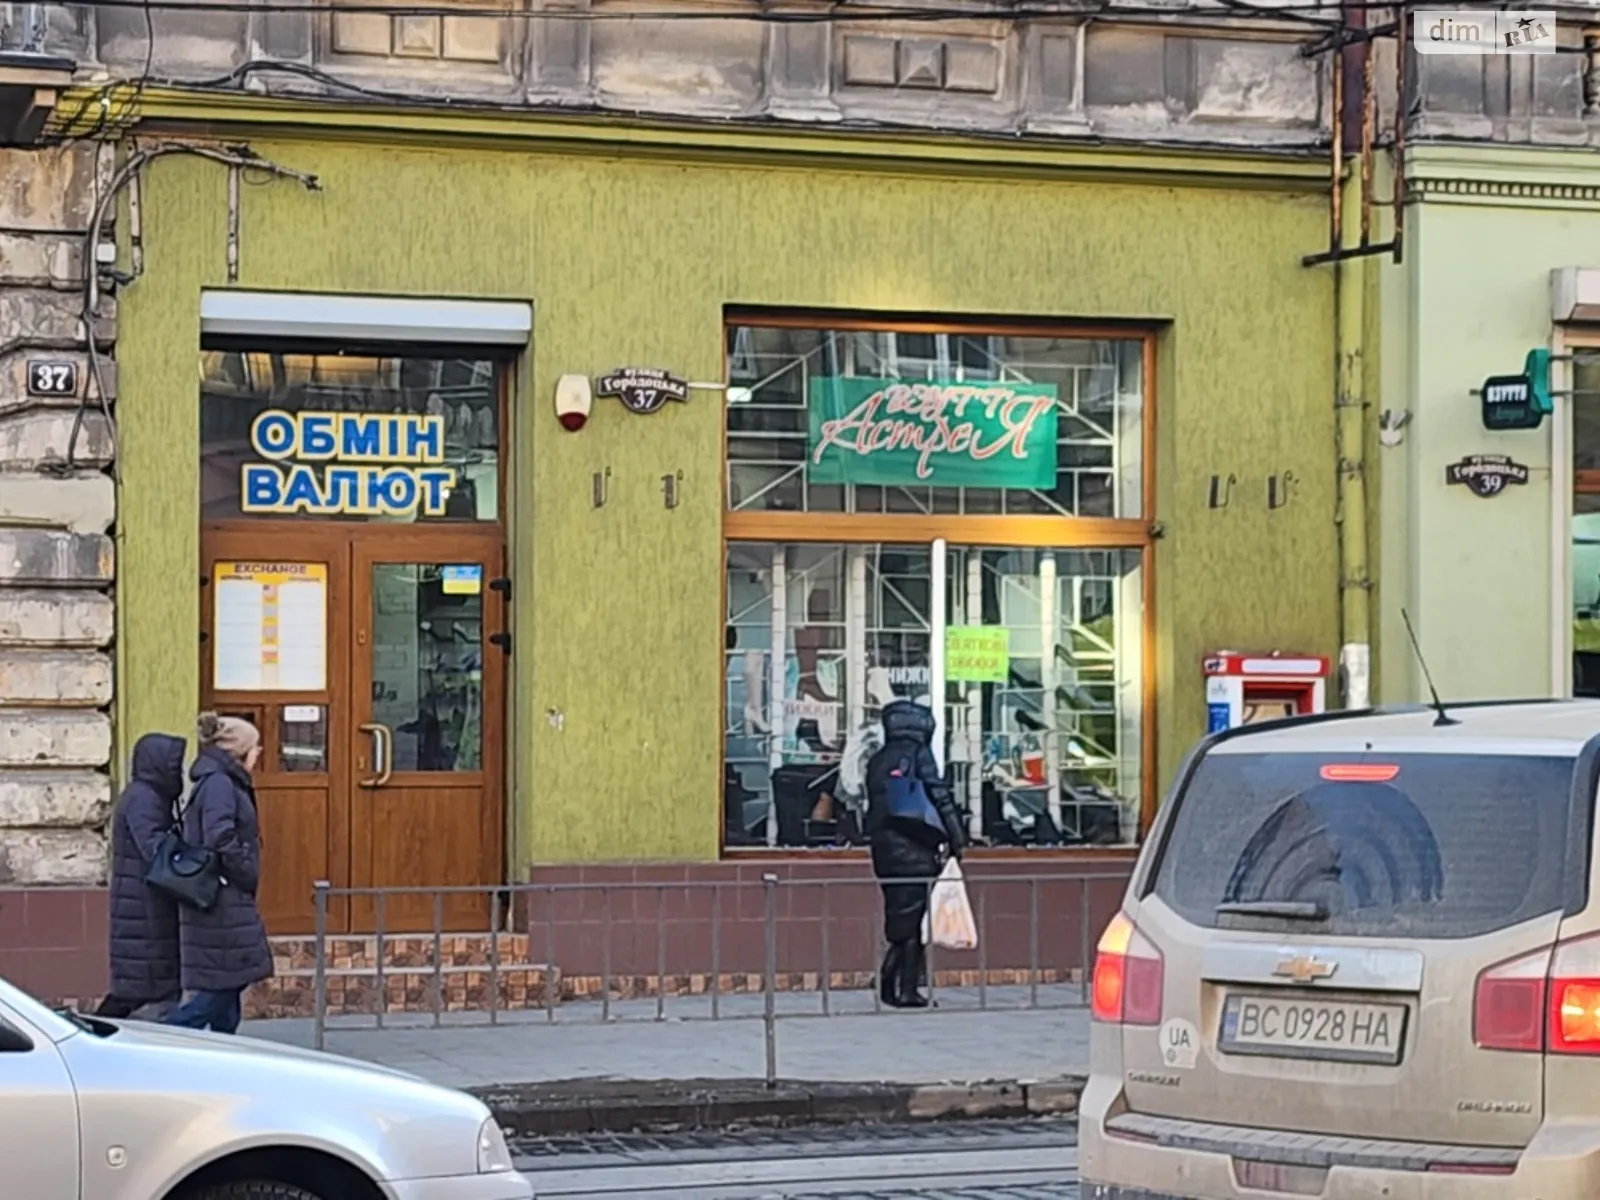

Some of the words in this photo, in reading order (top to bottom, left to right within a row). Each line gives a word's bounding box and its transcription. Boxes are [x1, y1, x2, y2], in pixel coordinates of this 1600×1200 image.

[37, 365, 70, 390] 37
[632, 389, 657, 409] 37
[254, 411, 442, 460] ОБМІН
[244, 465, 454, 513] ВАЛЮТ
[1480, 475, 1502, 493] 39
[234, 564, 307, 575] EXCHANGE
[1168, 1027, 1192, 1048] UA
